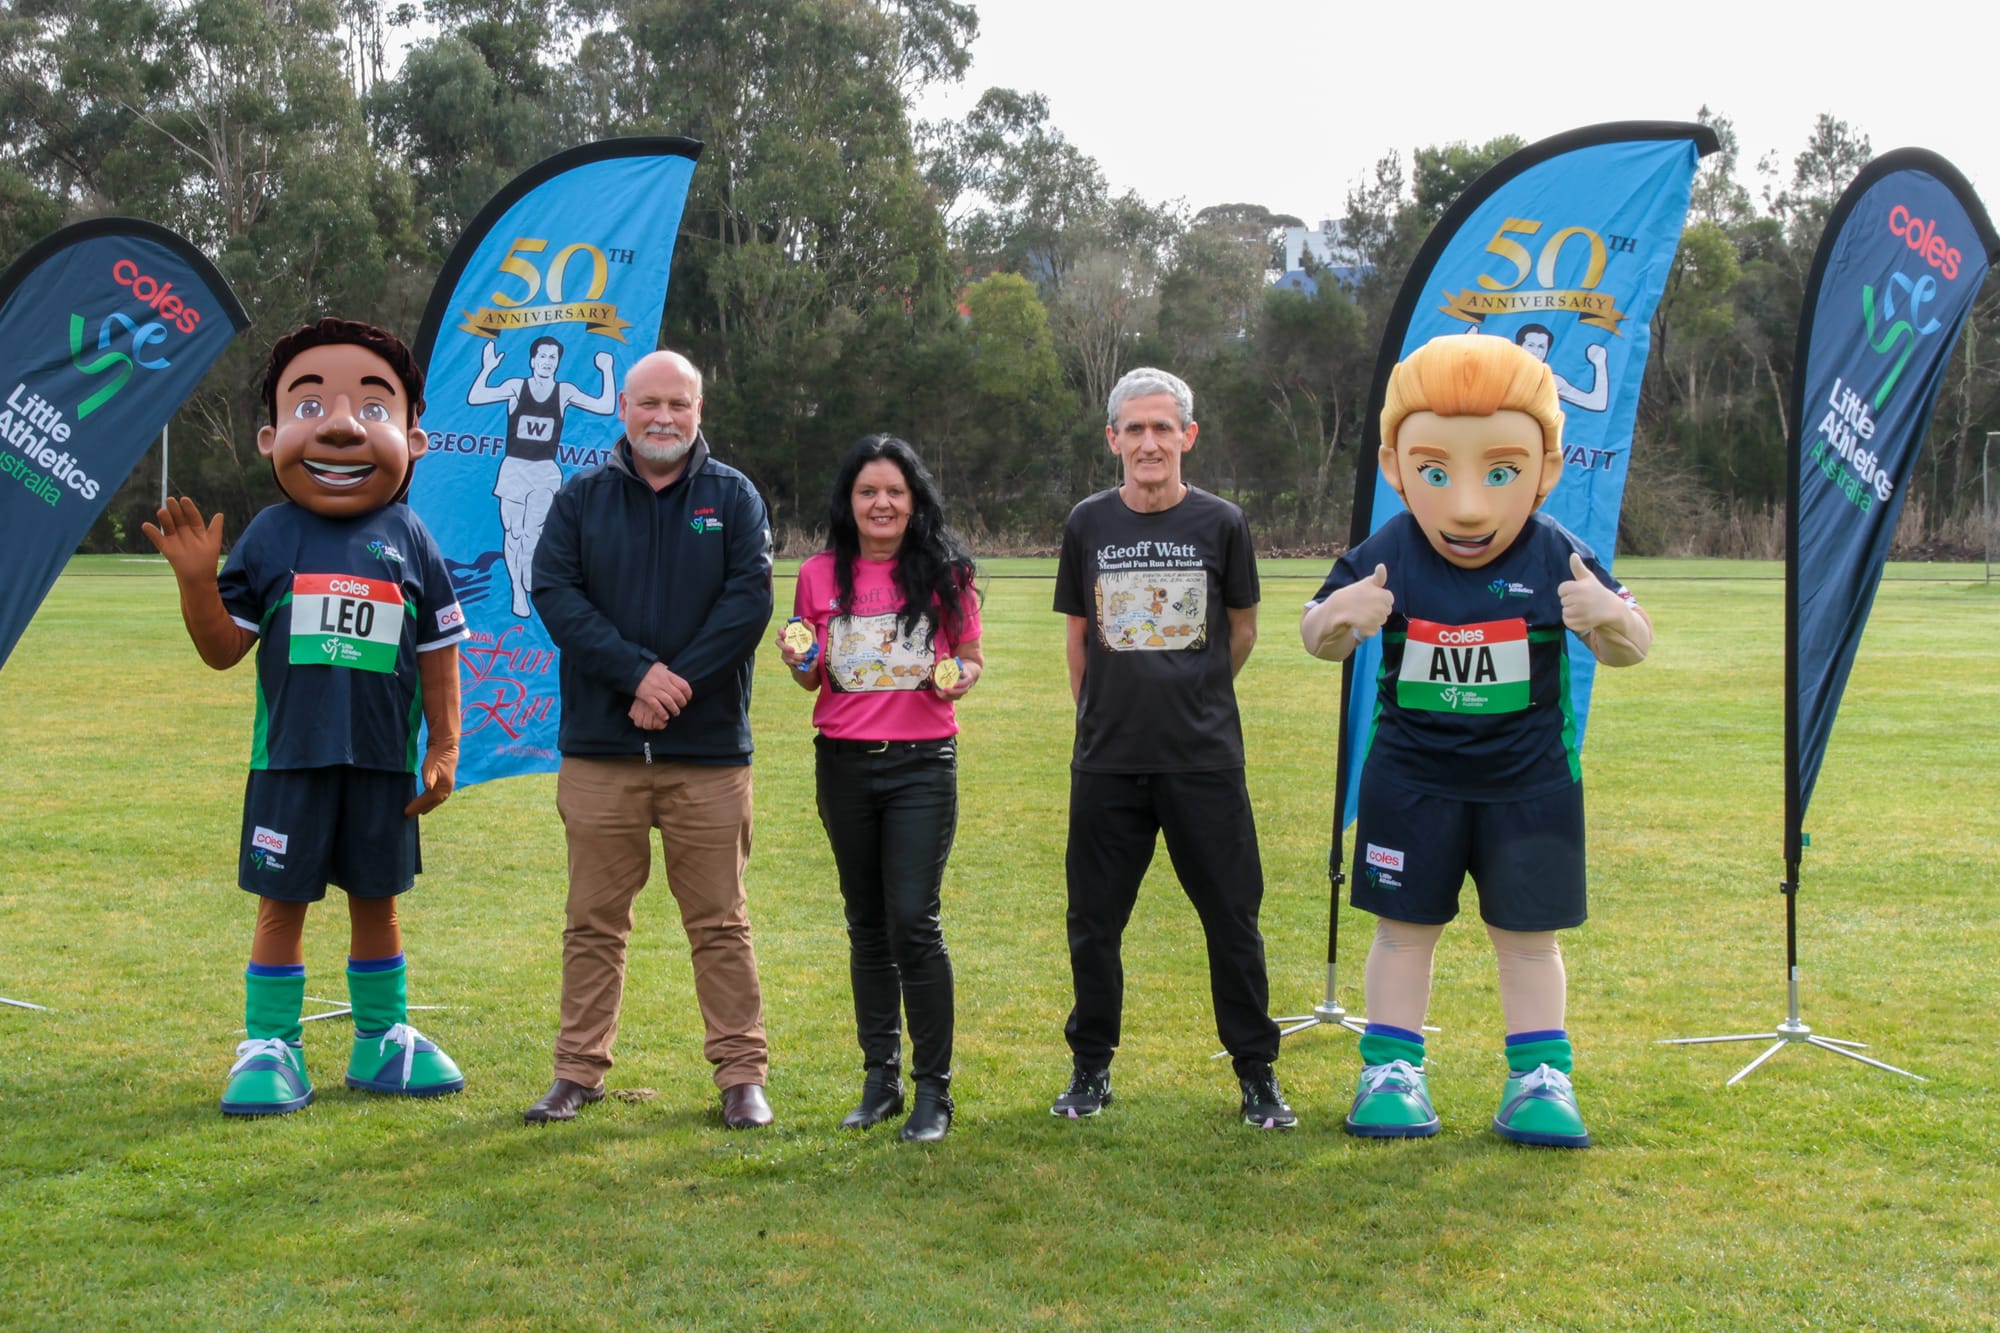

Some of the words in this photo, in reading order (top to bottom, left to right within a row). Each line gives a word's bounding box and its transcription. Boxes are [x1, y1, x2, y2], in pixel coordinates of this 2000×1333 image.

[1889, 205, 1962, 280] coles
[113, 259, 200, 334] coles
[483, 306, 612, 324] ANNIVERSARY
[1467, 295, 1608, 310] ANNIVERSARY
[6, 382, 72, 442] Little
[1828, 377, 1875, 440] Little
[0, 409, 100, 500] Athletics
[428, 431, 504, 456] GEOFF
[558, 444, 612, 468] WAT
[1818, 410, 1894, 502] Athletics
[0, 451, 62, 507] stralia
[1810, 440, 1873, 513] Australia
[1105, 541, 1152, 560] Geoff
[1154, 542, 1197, 558] Watt
[1133, 559, 1148, 568] Fun
[1150, 559, 1165, 568] Run
[1166, 559, 1174, 567] &
[1175, 559, 1203, 567] Festival
[329, 579, 371, 597] coles
[320, 596, 375, 638] LEO
[1438, 628, 1485, 644] coles
[469, 631, 495, 644] RIAL
[1429, 646, 1498, 684] AVA
[1369, 850, 1400, 866] coles
